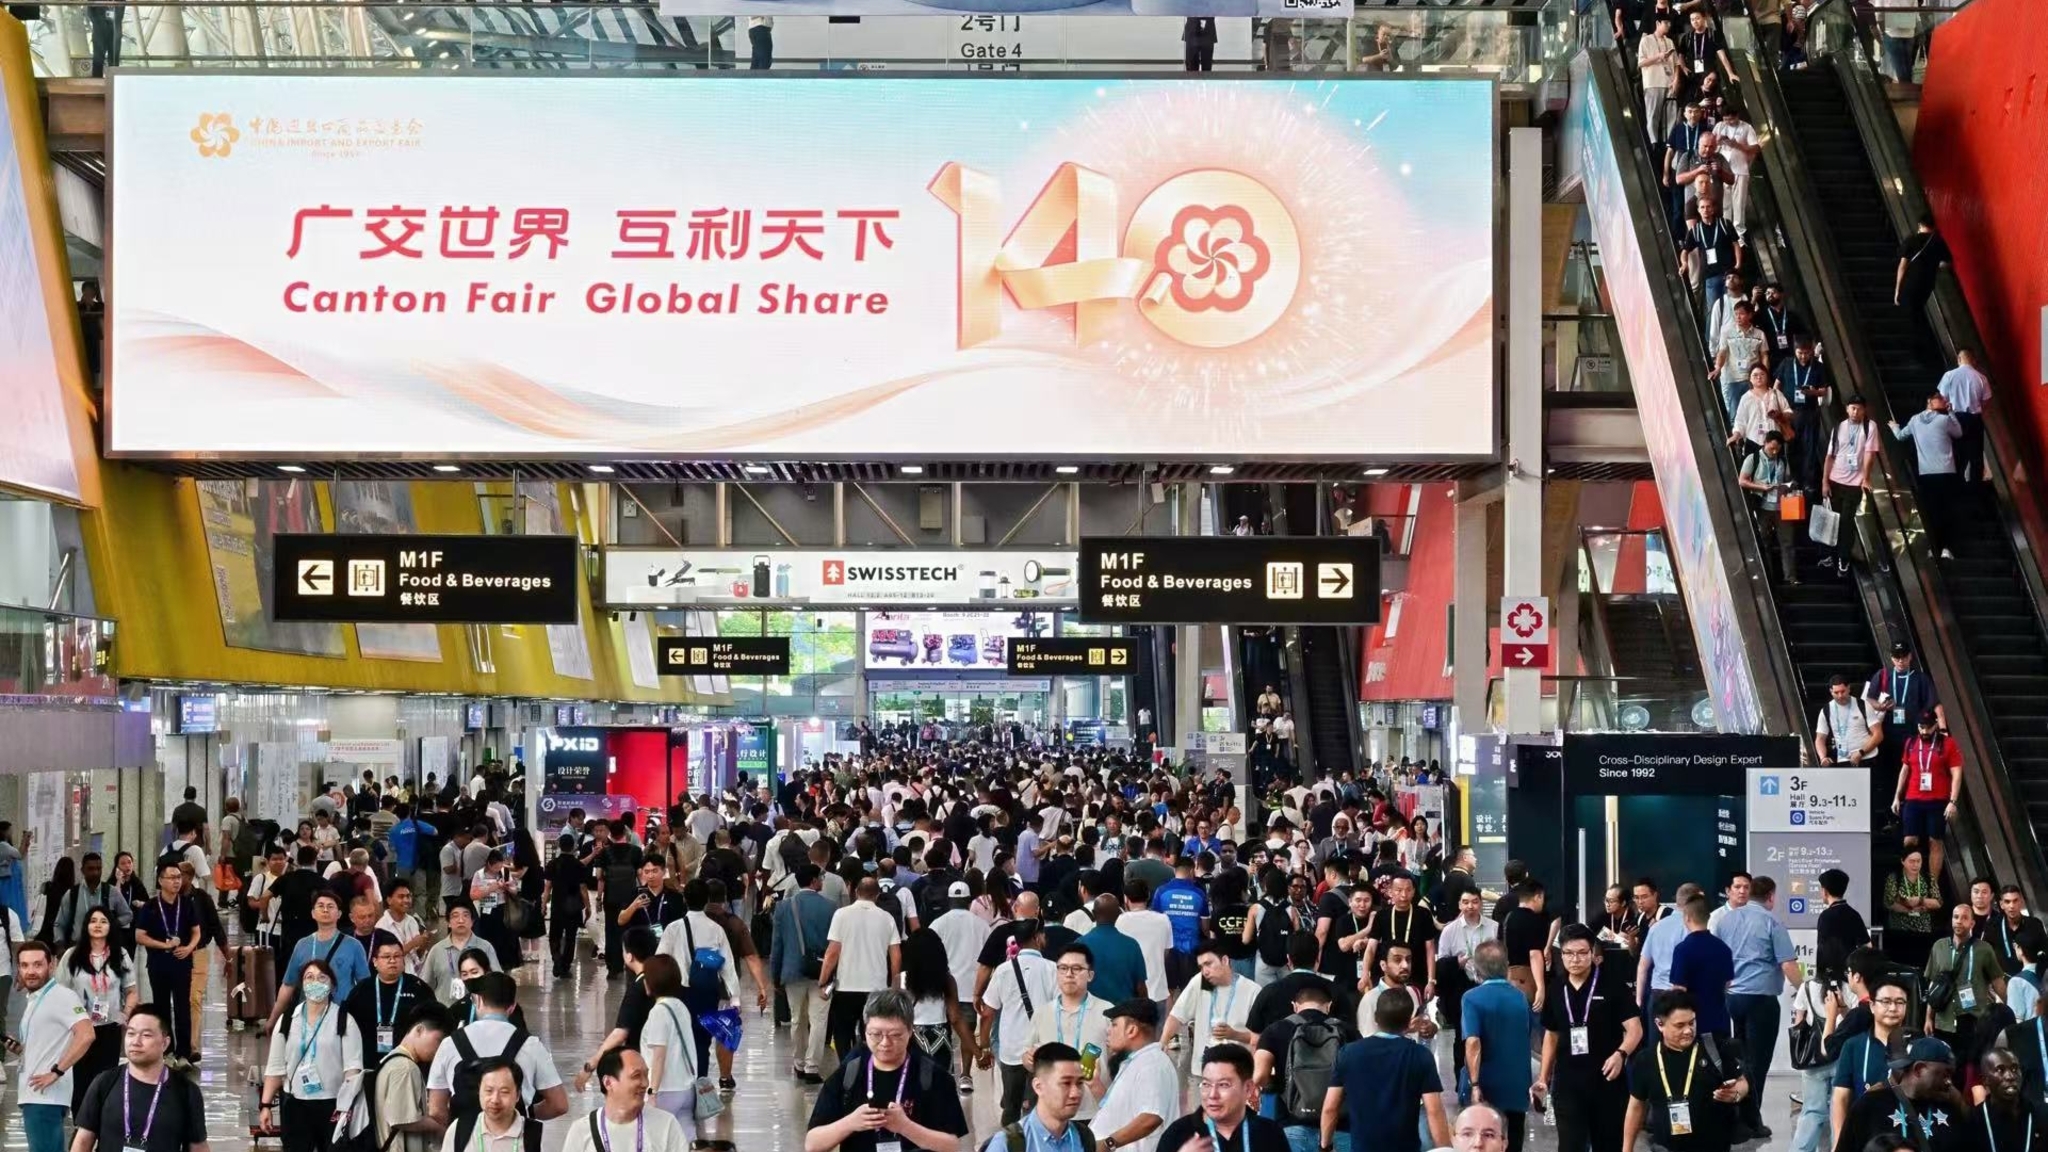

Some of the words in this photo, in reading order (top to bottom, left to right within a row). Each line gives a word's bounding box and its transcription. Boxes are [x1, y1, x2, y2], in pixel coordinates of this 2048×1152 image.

[961, 42, 1006, 58] Gate
[1012, 42, 1022, 58] 4
[287, 138, 326, 147] IMPORT
[330, 138, 352, 147] AND
[356, 138, 394, 147] EXPORT
[398, 138, 421, 147] FAIR
[286, 204, 571, 261] 广交世界
[611, 206, 900, 261] 互利天下
[284, 280, 447, 314] Canton
[467, 281, 556, 314] Fair
[586, 281, 739, 314] Global
[758, 281, 890, 314] Share
[400, 552, 443, 568] M1F
[1101, 553, 1144, 570] M1F
[400, 573, 442, 587] Food
[446, 574, 458, 587] &
[462, 574, 551, 590] Beverages
[1101, 575, 1142, 588] Food
[1148, 576, 1159, 588] &
[1164, 576, 1252, 592] Beverages
[400, 593, 440, 606] 餐饮区
[1102, 594, 1142, 607] 餐饮区
[713, 644, 733, 652] M1F
[1016, 644, 1036, 652] M1F
[741, 654, 780, 662] Beverages
[1044, 654, 1082, 662] Beverages
[1694, 755, 1728, 766] Design
[1730, 755, 1762, 765] Expert
[1599, 768, 1628, 778] Since
[1632, 768, 1656, 778] 1992
[1790, 776, 1808, 791] 3F
[1809, 795, 1857, 808] 9.3-11.3
[1767, 846, 1785, 861] 2F
